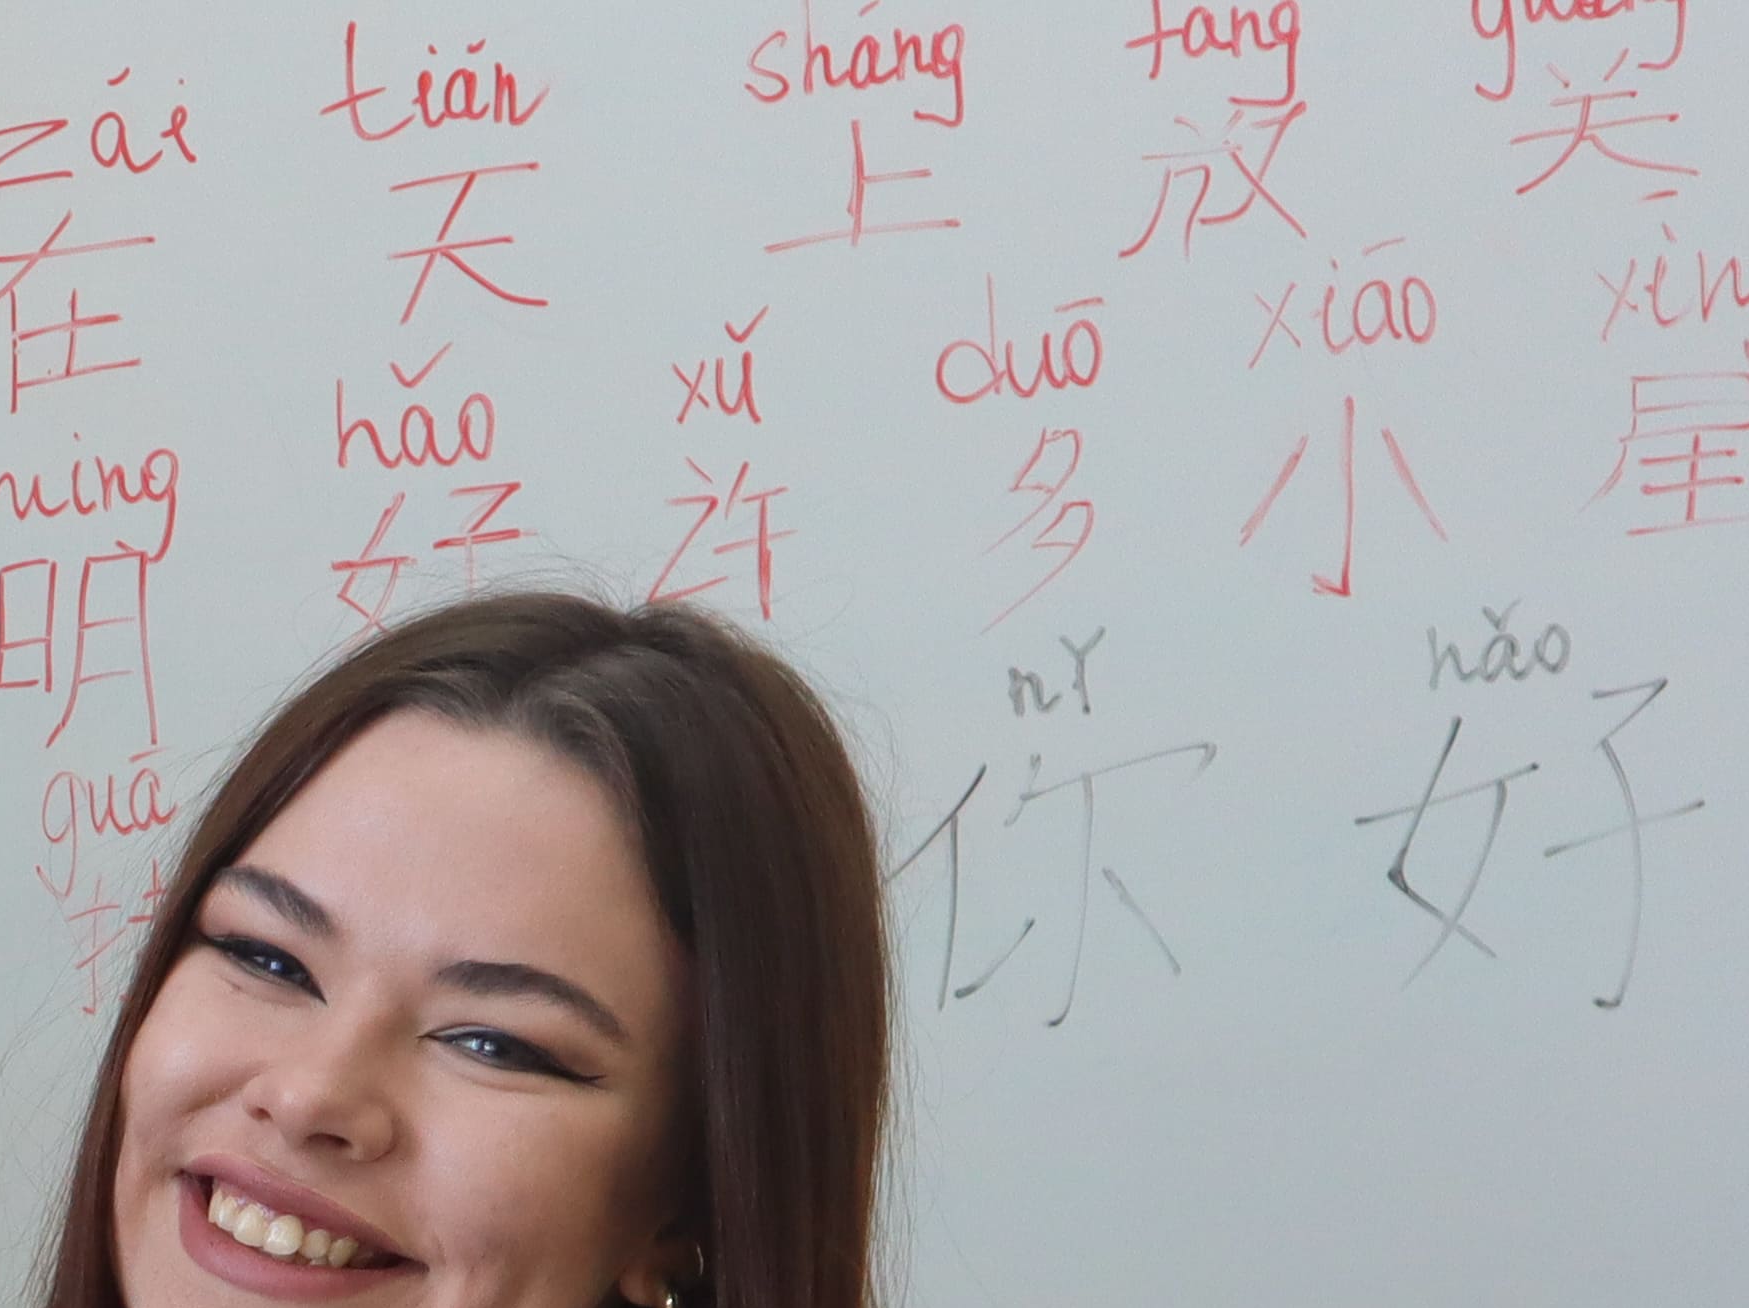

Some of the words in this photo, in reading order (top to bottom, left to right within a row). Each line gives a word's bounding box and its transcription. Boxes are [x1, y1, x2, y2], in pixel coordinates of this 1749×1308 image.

[387, 161, 549, 324] 天
[764, 119, 961, 252] 上
[979, 427, 1095, 635] 多
[1239, 396, 1448, 597] 小
